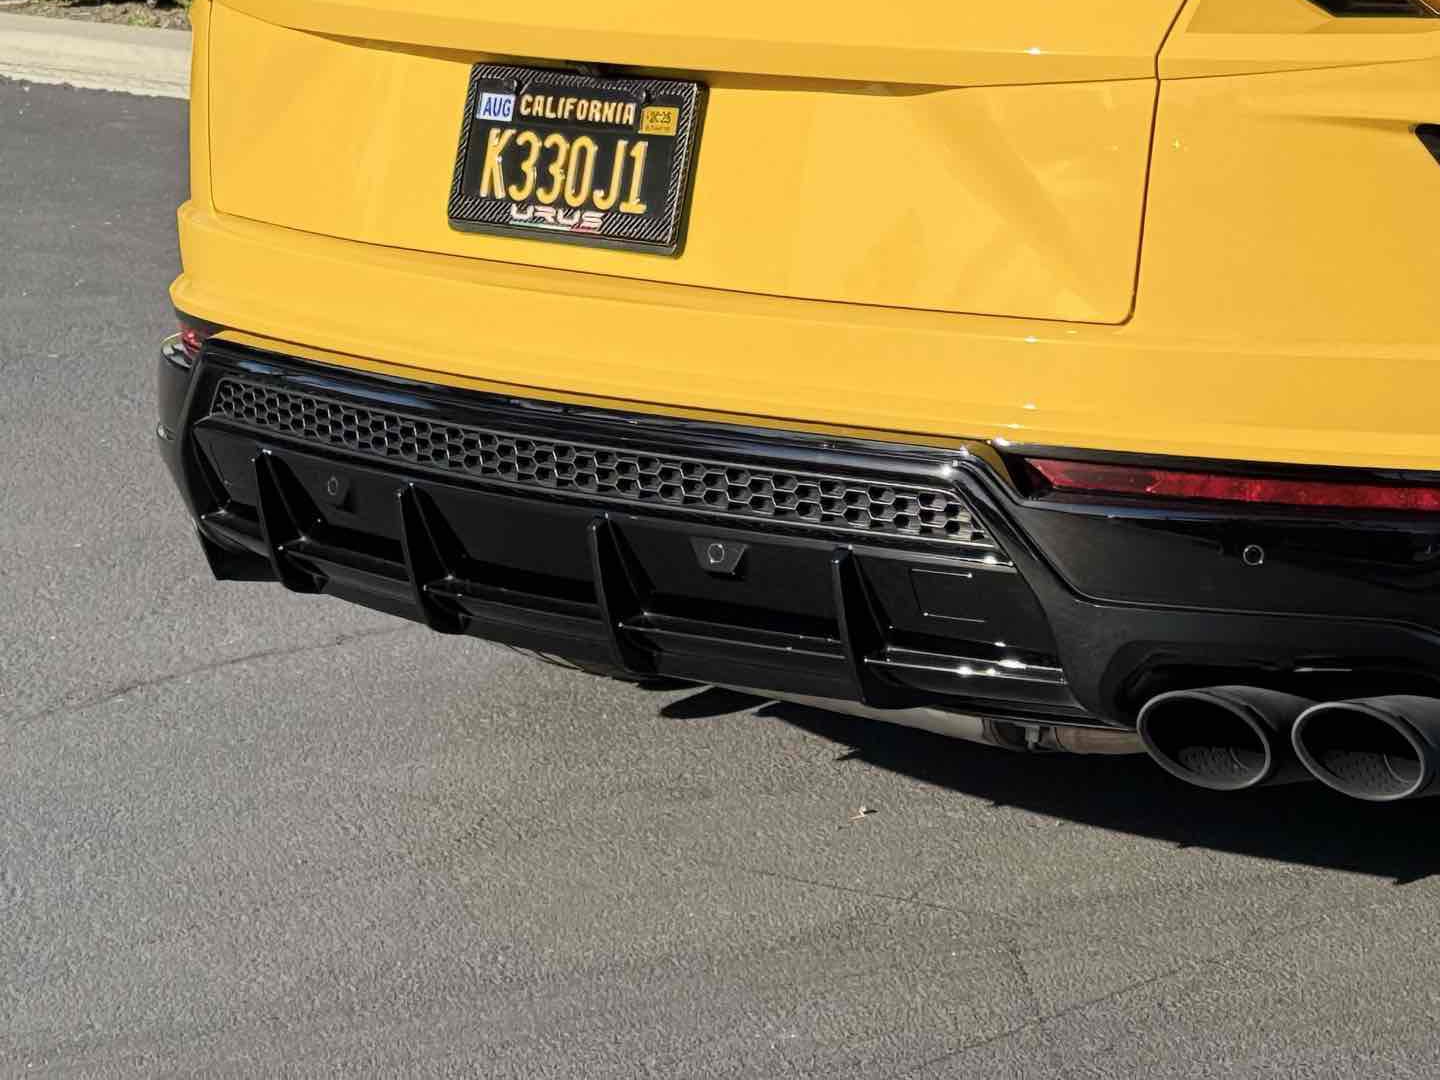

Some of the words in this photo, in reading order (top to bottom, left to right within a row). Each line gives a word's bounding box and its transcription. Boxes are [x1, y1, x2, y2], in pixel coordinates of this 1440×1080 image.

[483, 96, 512, 117] AUG
[520, 94, 637, 125] CALIFORNIA
[479, 127, 649, 214] K330J1
[511, 203, 606, 227] URUS
